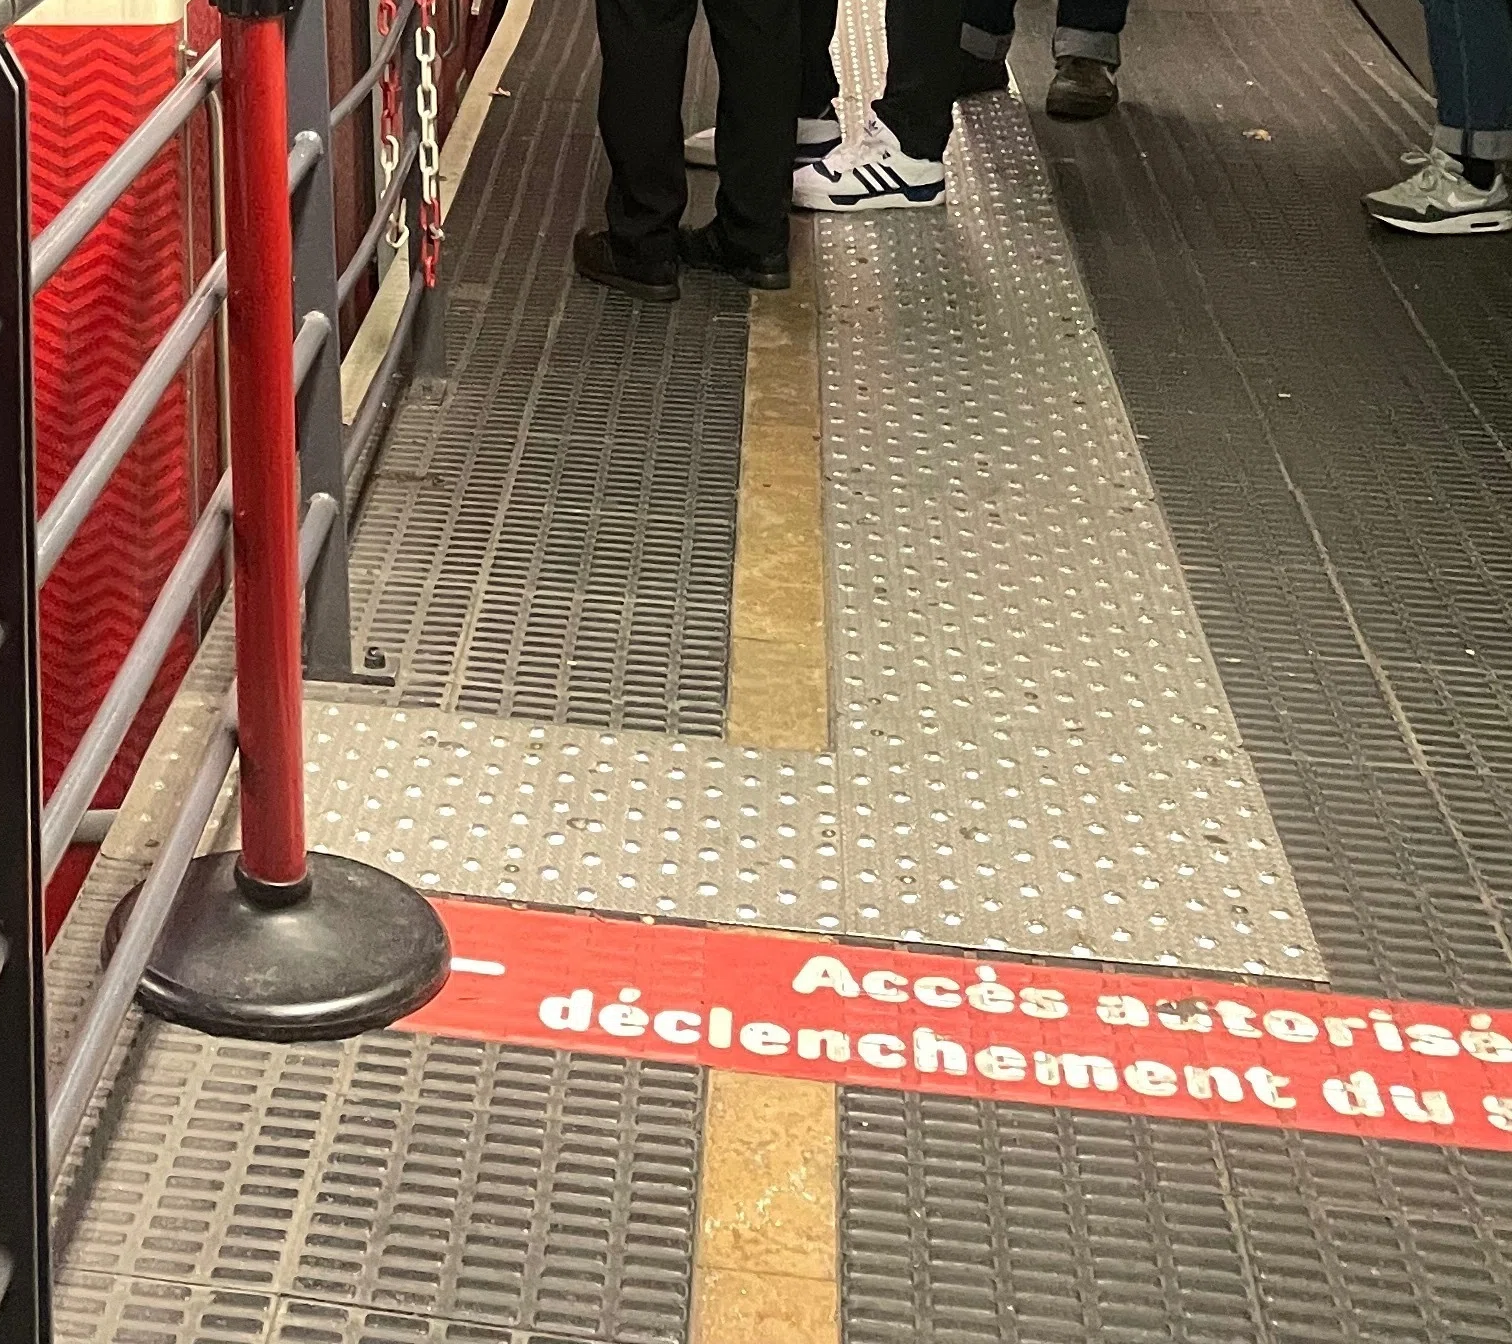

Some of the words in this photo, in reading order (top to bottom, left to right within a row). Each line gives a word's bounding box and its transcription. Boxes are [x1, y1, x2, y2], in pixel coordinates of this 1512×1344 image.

[792, 955, 1069, 1020] Accès
[539, 988, 1296, 1108] déclenchement
[1322, 1069, 1455, 1126] du
